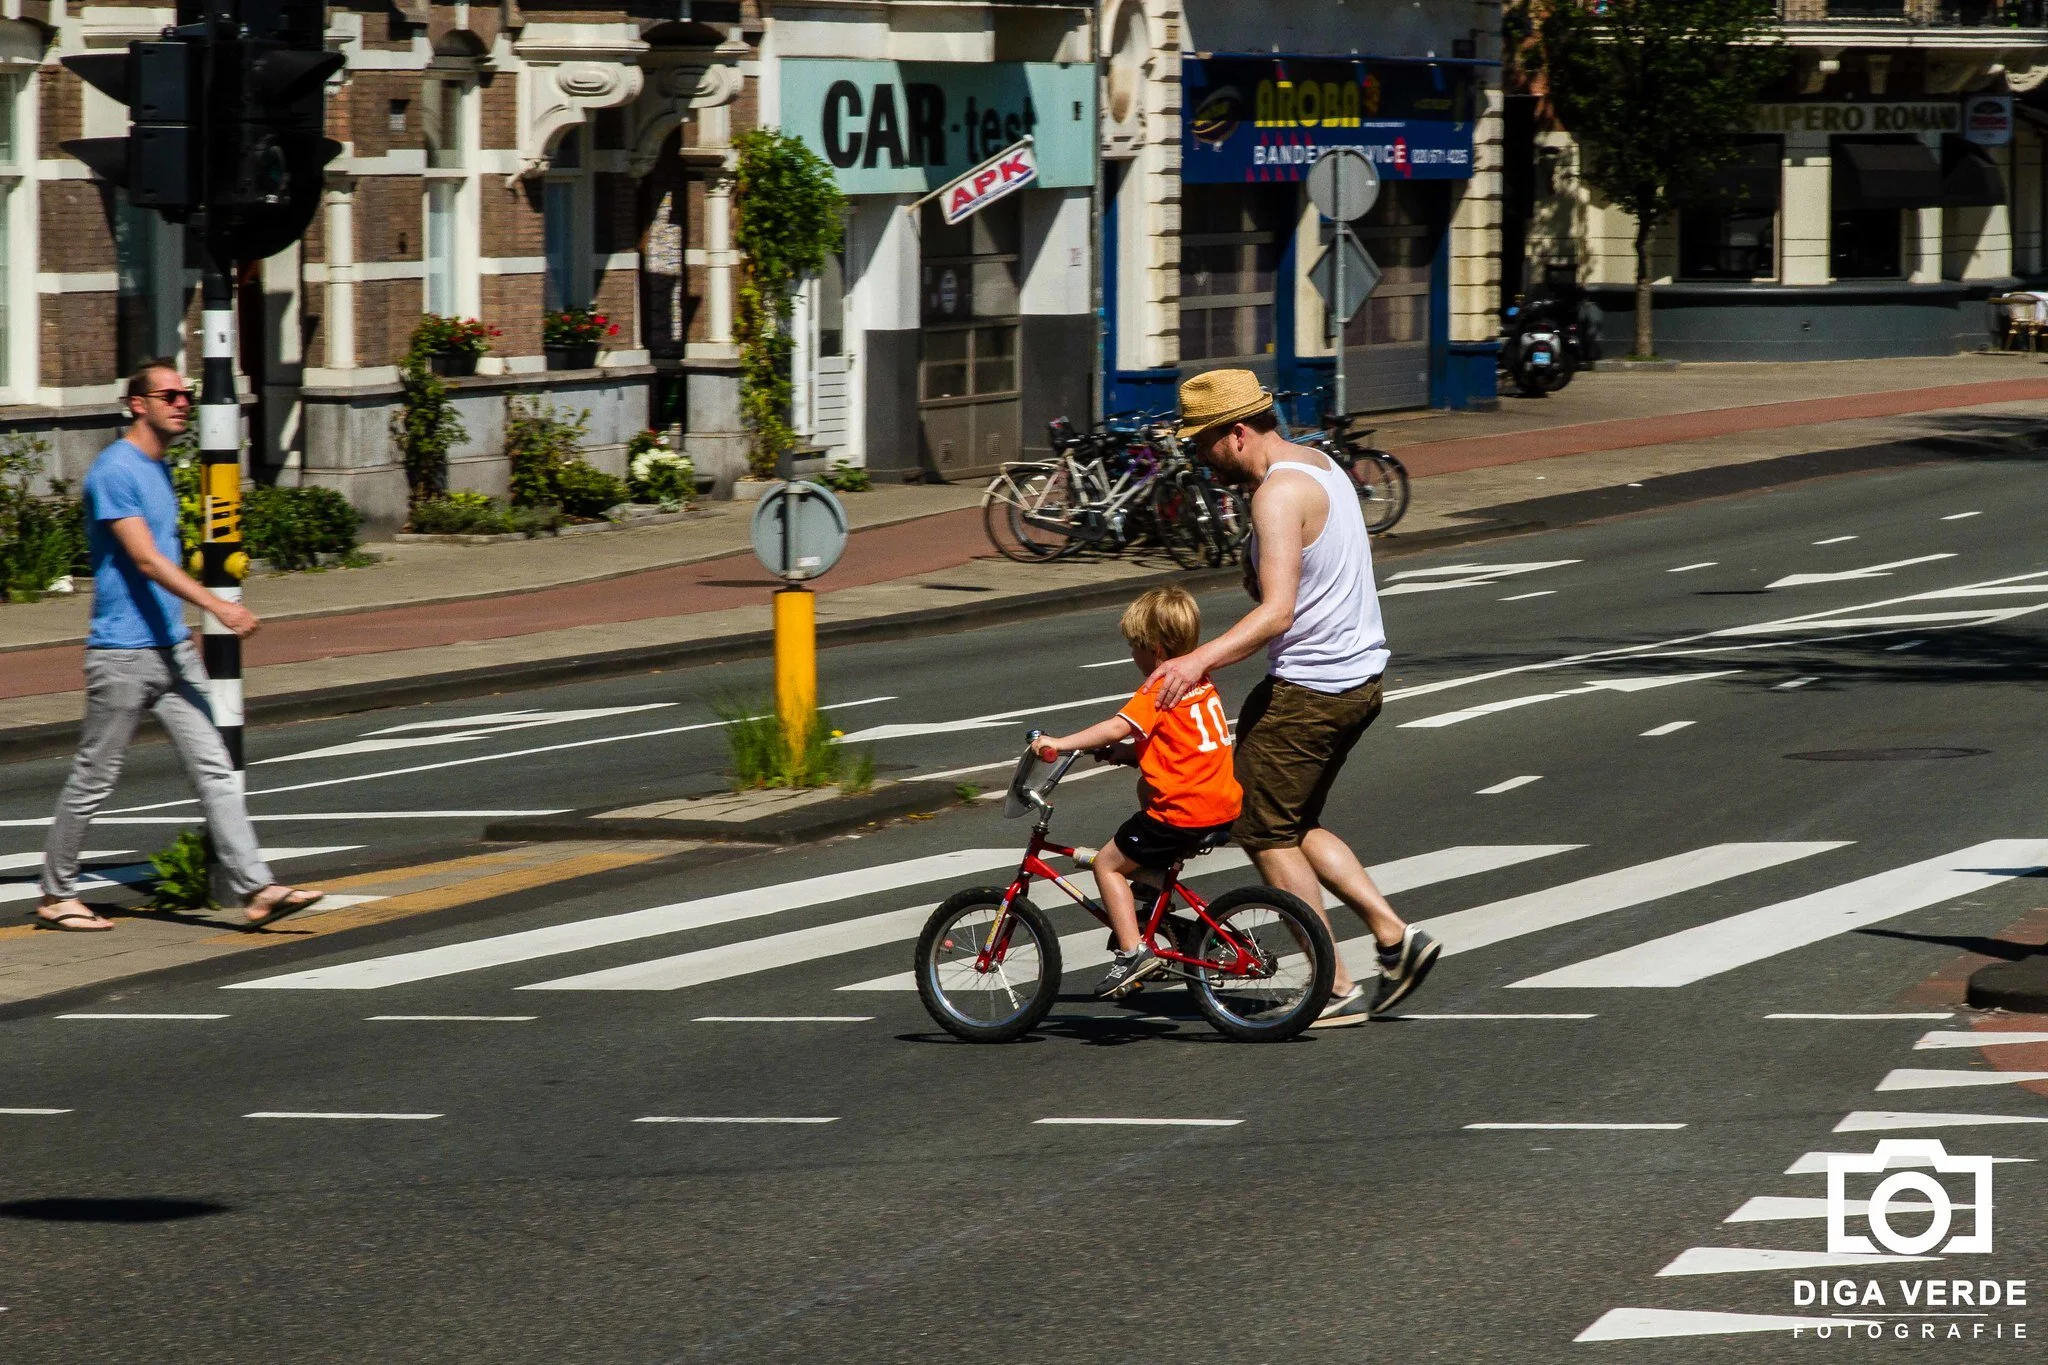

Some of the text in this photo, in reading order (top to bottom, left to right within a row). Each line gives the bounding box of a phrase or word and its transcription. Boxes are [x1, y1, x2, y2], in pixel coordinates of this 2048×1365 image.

[1254, 80, 1361, 128] AROBA
[1253, 144, 1407, 165] BANDENVICE
[950, 152, 1031, 213] APK
[1190, 697, 1232, 752] 10
